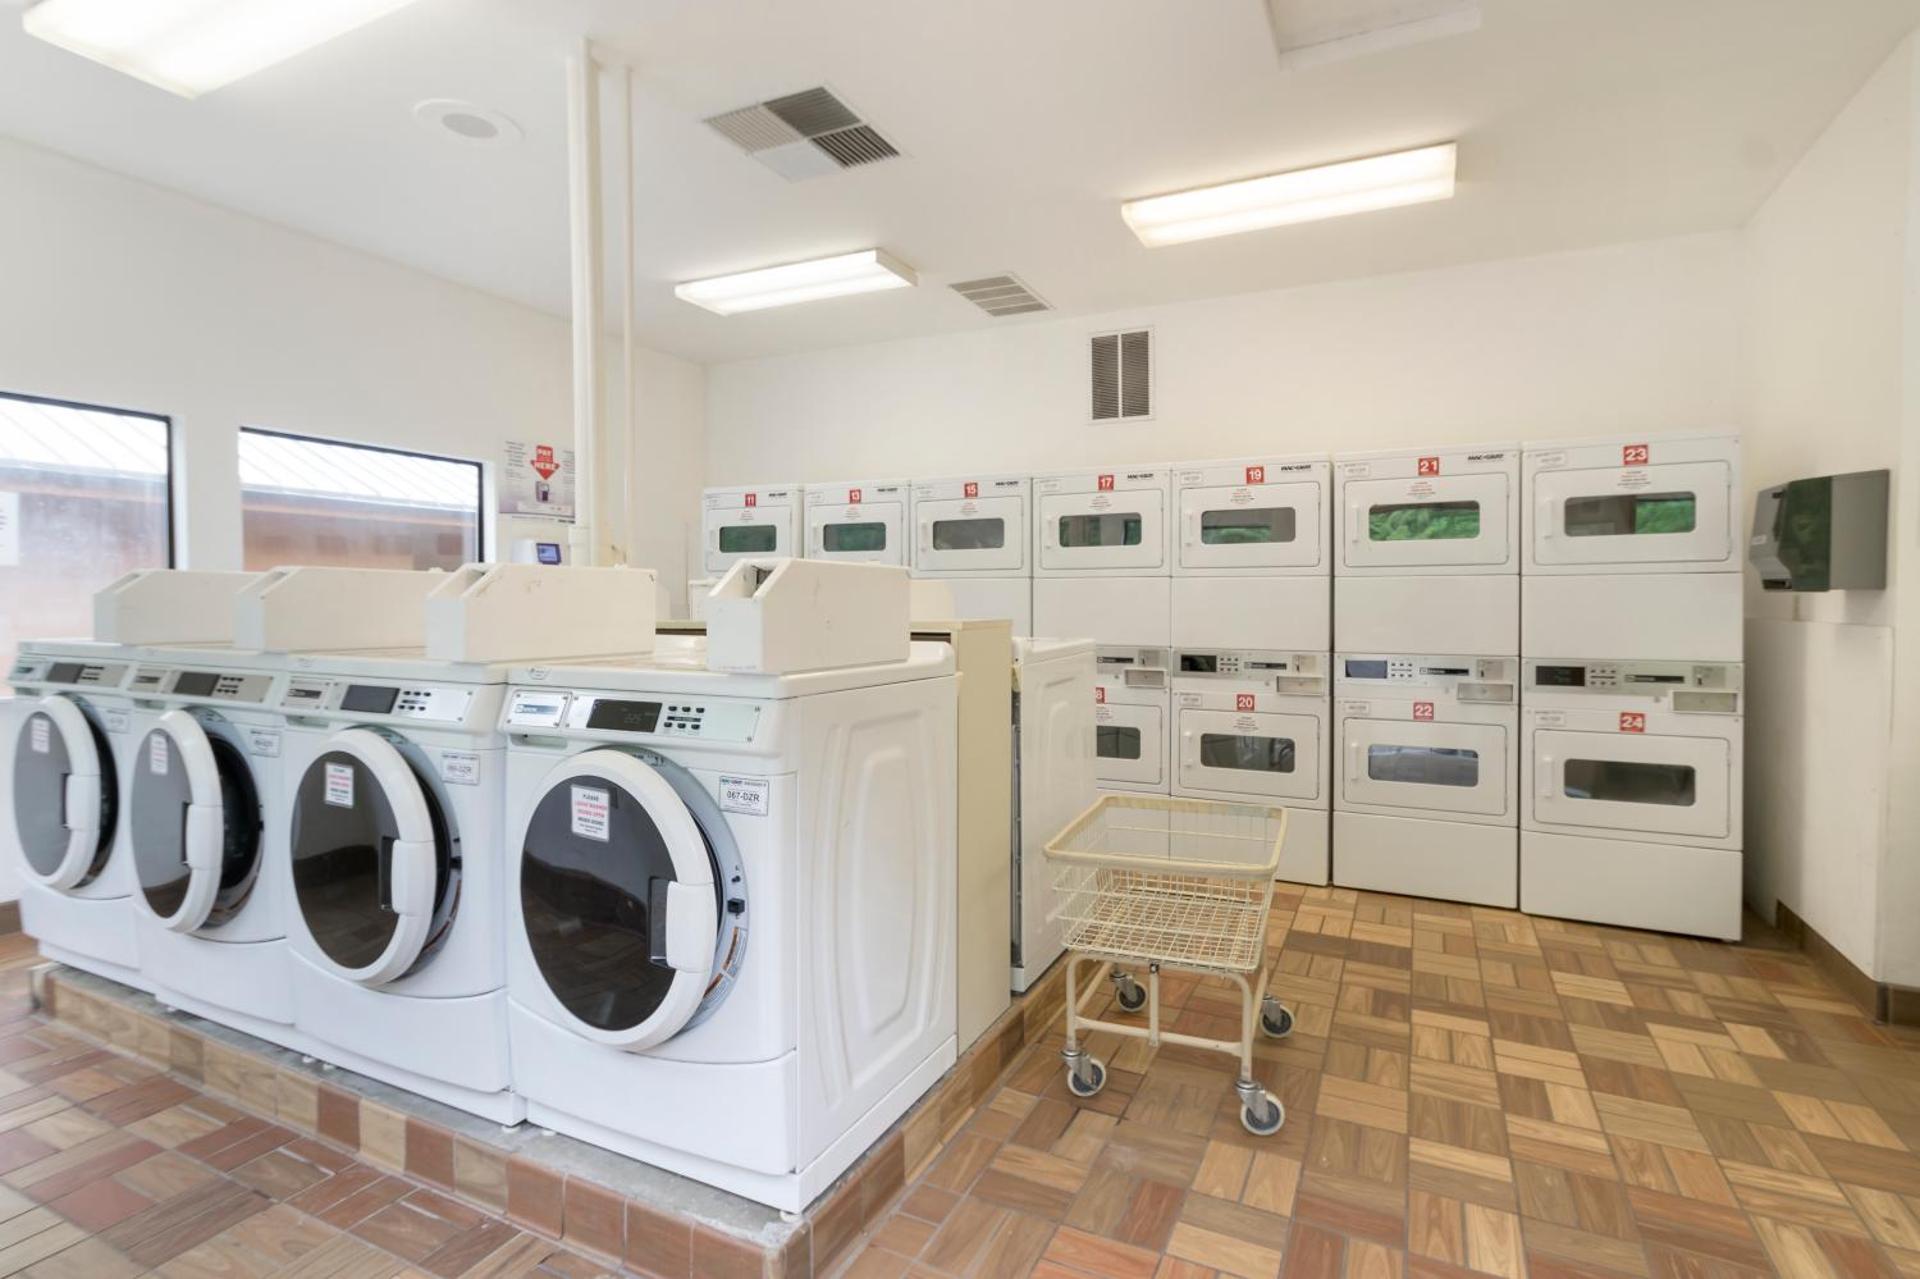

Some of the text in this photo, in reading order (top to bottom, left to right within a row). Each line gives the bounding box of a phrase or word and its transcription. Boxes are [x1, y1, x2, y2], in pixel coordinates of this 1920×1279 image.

[1625, 448, 1647, 461] 23
[1420, 460, 1437, 471] 21
[1248, 469, 1262, 480] 19
[1100, 478, 1112, 488] 17
[966, 485, 976, 495] 15
[747, 496, 754, 505] 11
[852, 492, 860, 501] 13
[1238, 697, 1253, 708] 20
[1415, 705, 1432, 717] 22
[1622, 716, 1643, 729] 24
